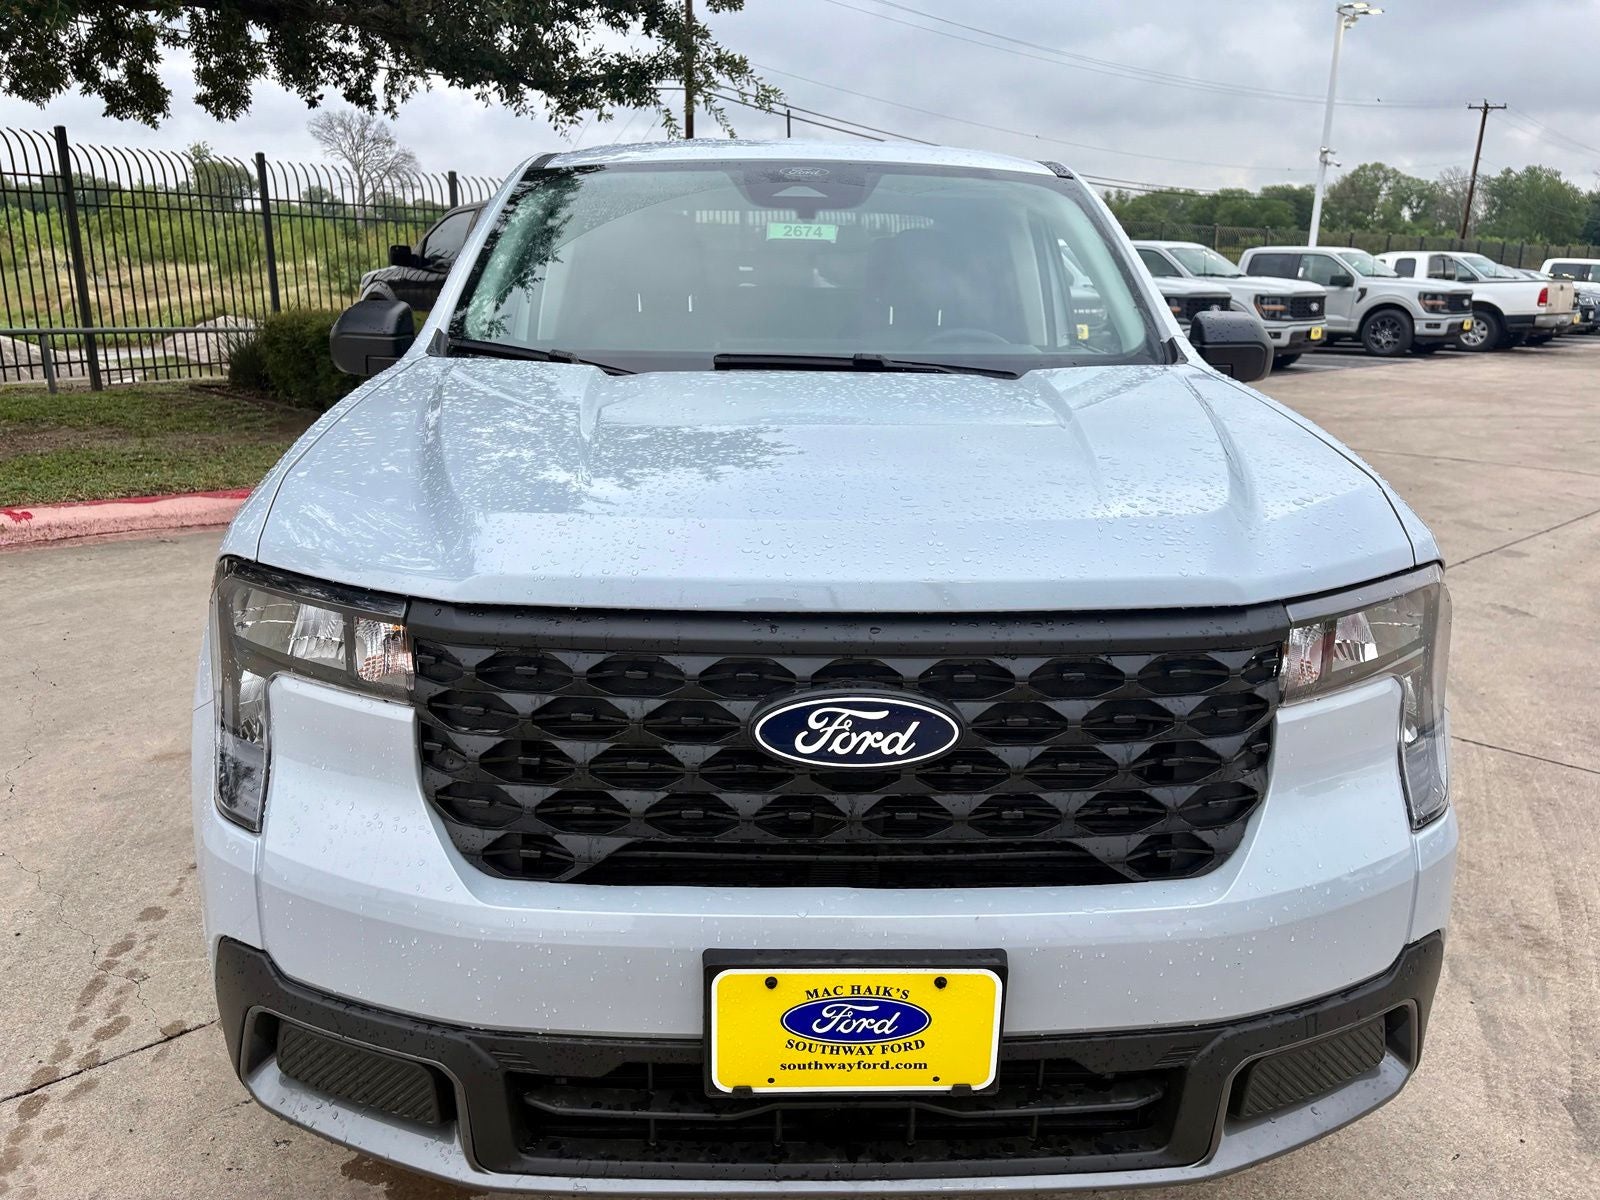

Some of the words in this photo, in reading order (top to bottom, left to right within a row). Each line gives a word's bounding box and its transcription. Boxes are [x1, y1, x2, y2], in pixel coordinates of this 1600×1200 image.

[787, 167, 821, 176] Ford
[783, 225, 823, 237] 2674
[794, 707, 920, 755] Ford
[805, 985, 844, 1000] MAC
[812, 1003, 901, 1034] Ford
[785, 1039, 875, 1056] SOUTHWAY
[880, 1039, 925, 1054] FORD
[780, 1060, 928, 1072] southwayford.com
